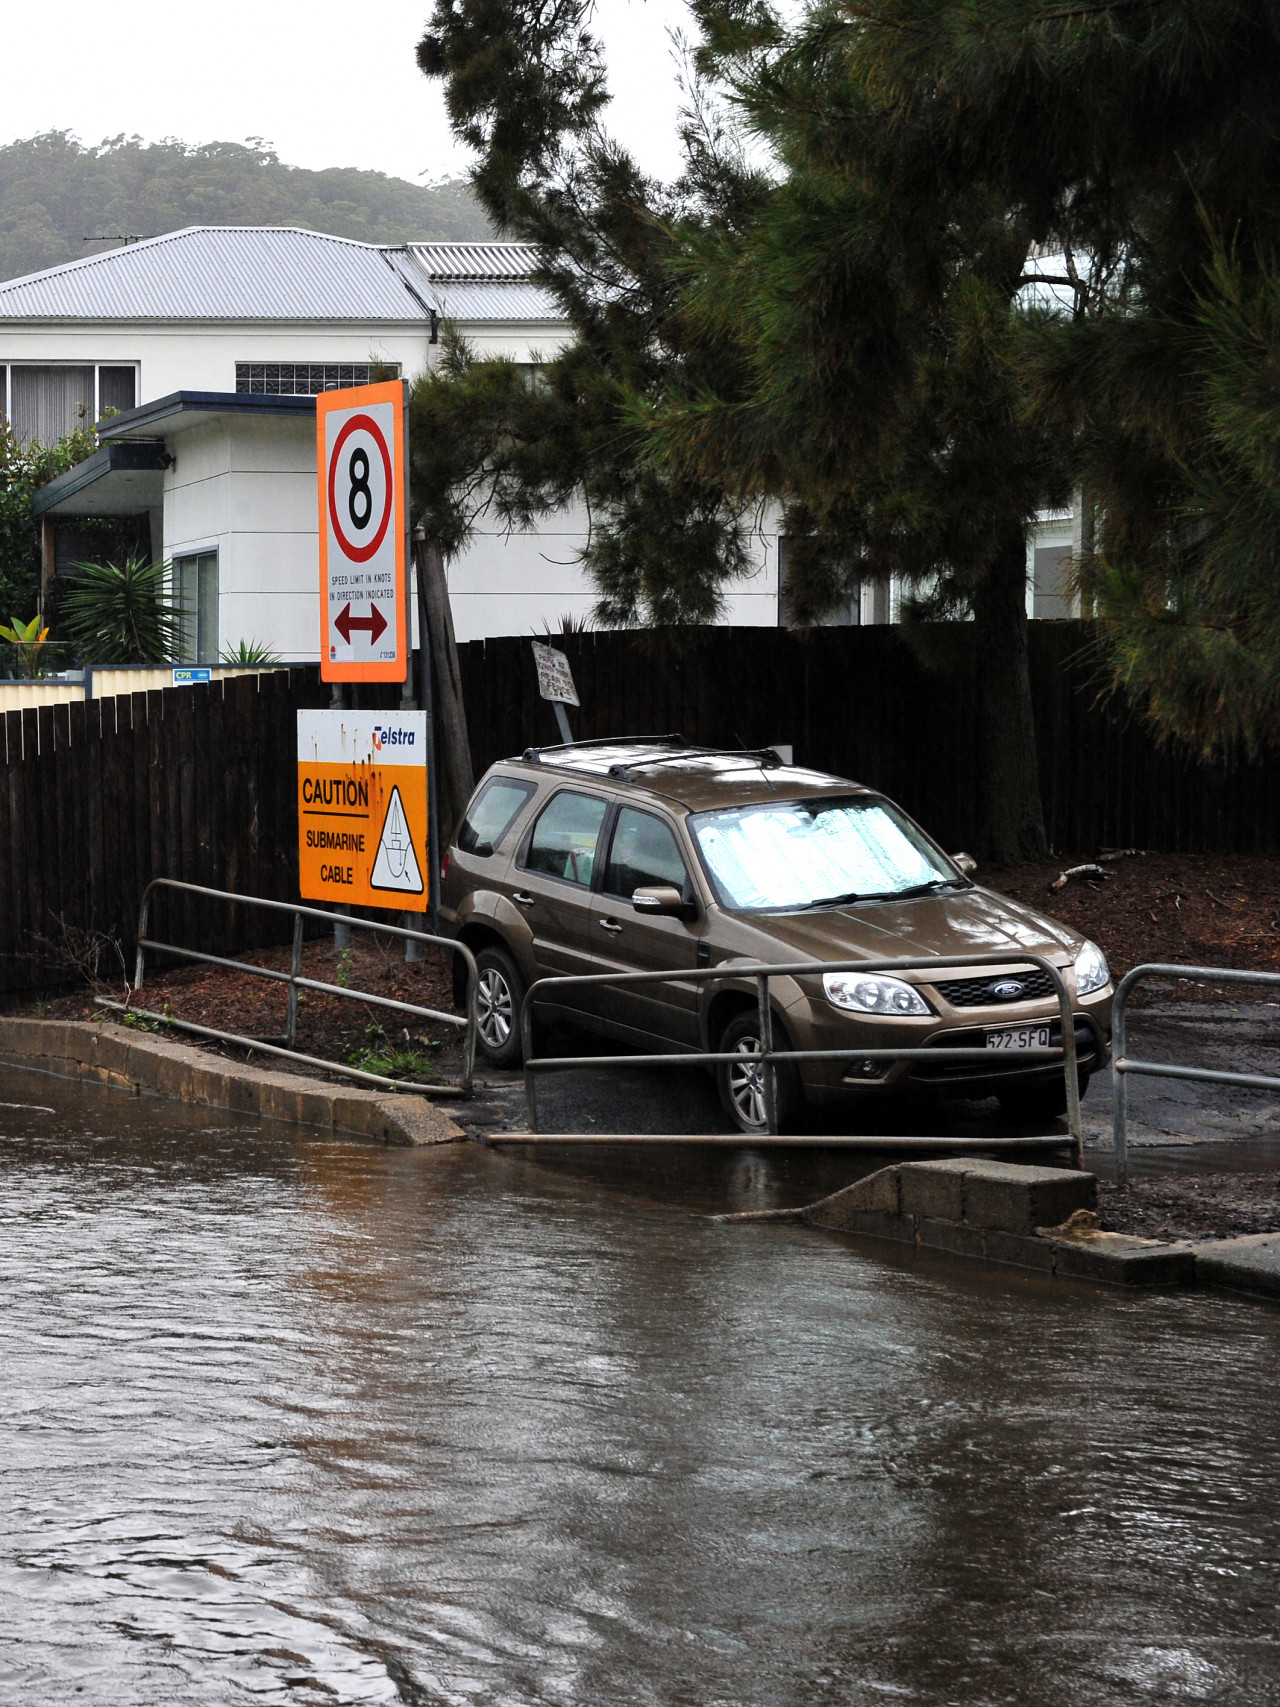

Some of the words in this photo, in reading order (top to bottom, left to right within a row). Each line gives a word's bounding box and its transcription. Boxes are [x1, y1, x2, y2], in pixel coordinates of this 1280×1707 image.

[348, 447, 372, 530] 8
[331, 575, 348, 586] SPEED
[350, 574, 364, 585] LIMIT
[365, 574, 372, 584] IN
[374, 572, 392, 583] KNOTS
[329, 591, 335, 601] IN
[337, 590, 363, 601] DIRECTION
[365, 588, 394, 600] INDICATED
[176, 671, 192, 679] CPR
[372, 726, 415, 750] Telstra
[302, 777, 369, 807] CAUTION
[306, 829, 365, 852] SUBMARINE
[320, 864, 353, 885] CABLE
